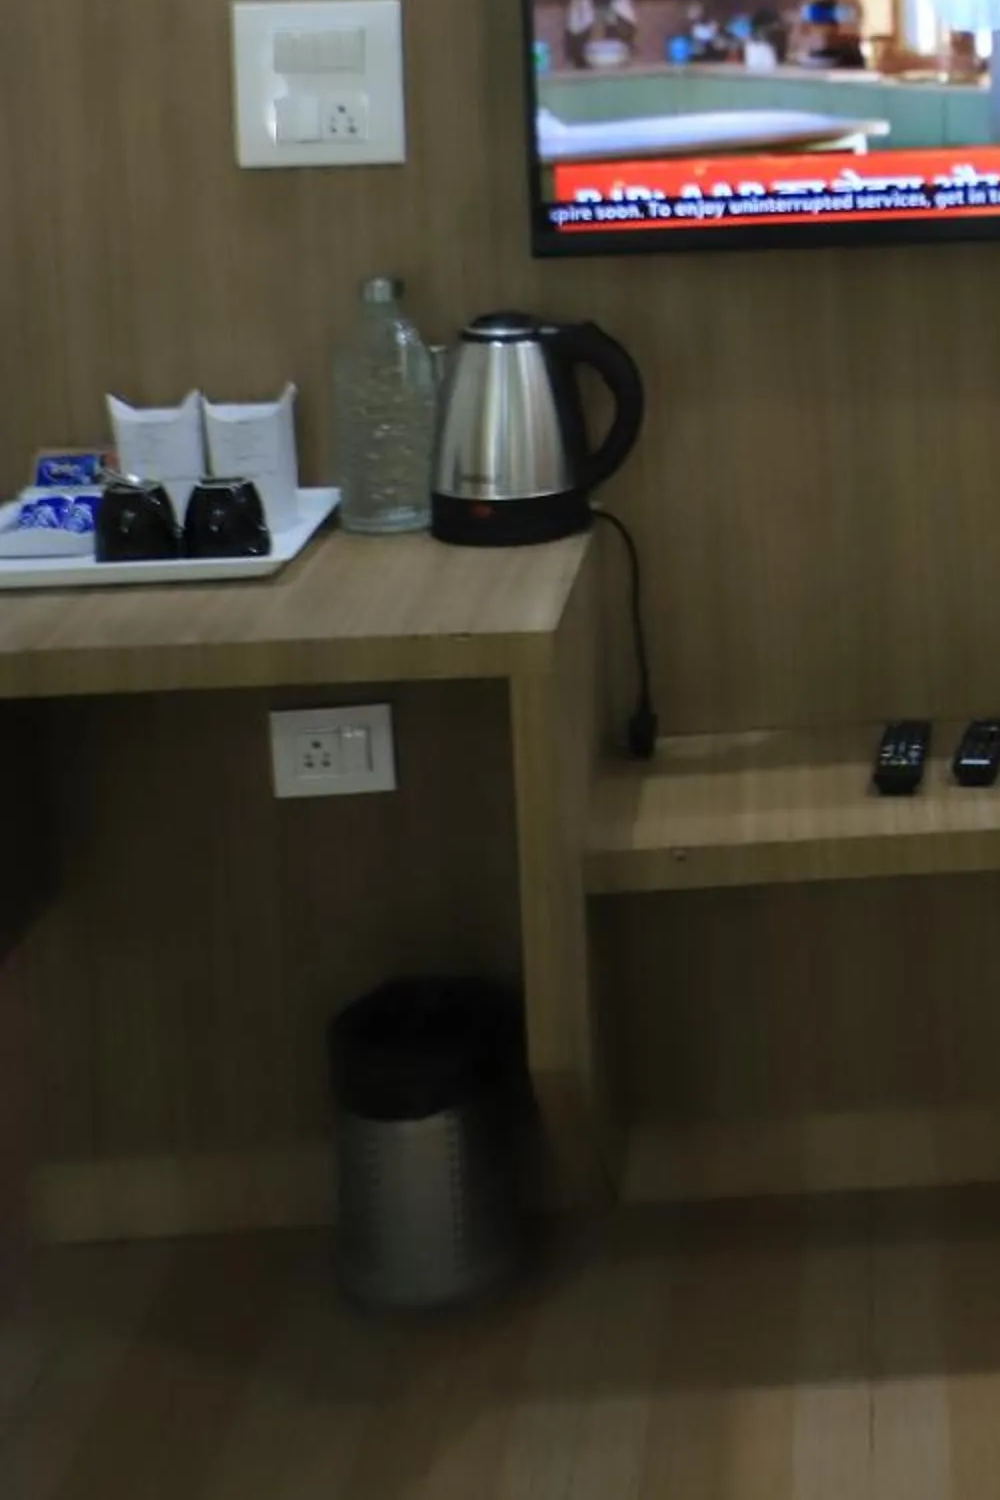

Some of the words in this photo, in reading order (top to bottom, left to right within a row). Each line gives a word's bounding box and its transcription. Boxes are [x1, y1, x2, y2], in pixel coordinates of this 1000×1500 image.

[648, 200, 671, 217] To
[674, 198, 726, 219] enjoy
[729, 192, 853, 214] uninterrupted
[934, 192, 965, 210] get
[968, 188, 987, 205] in
